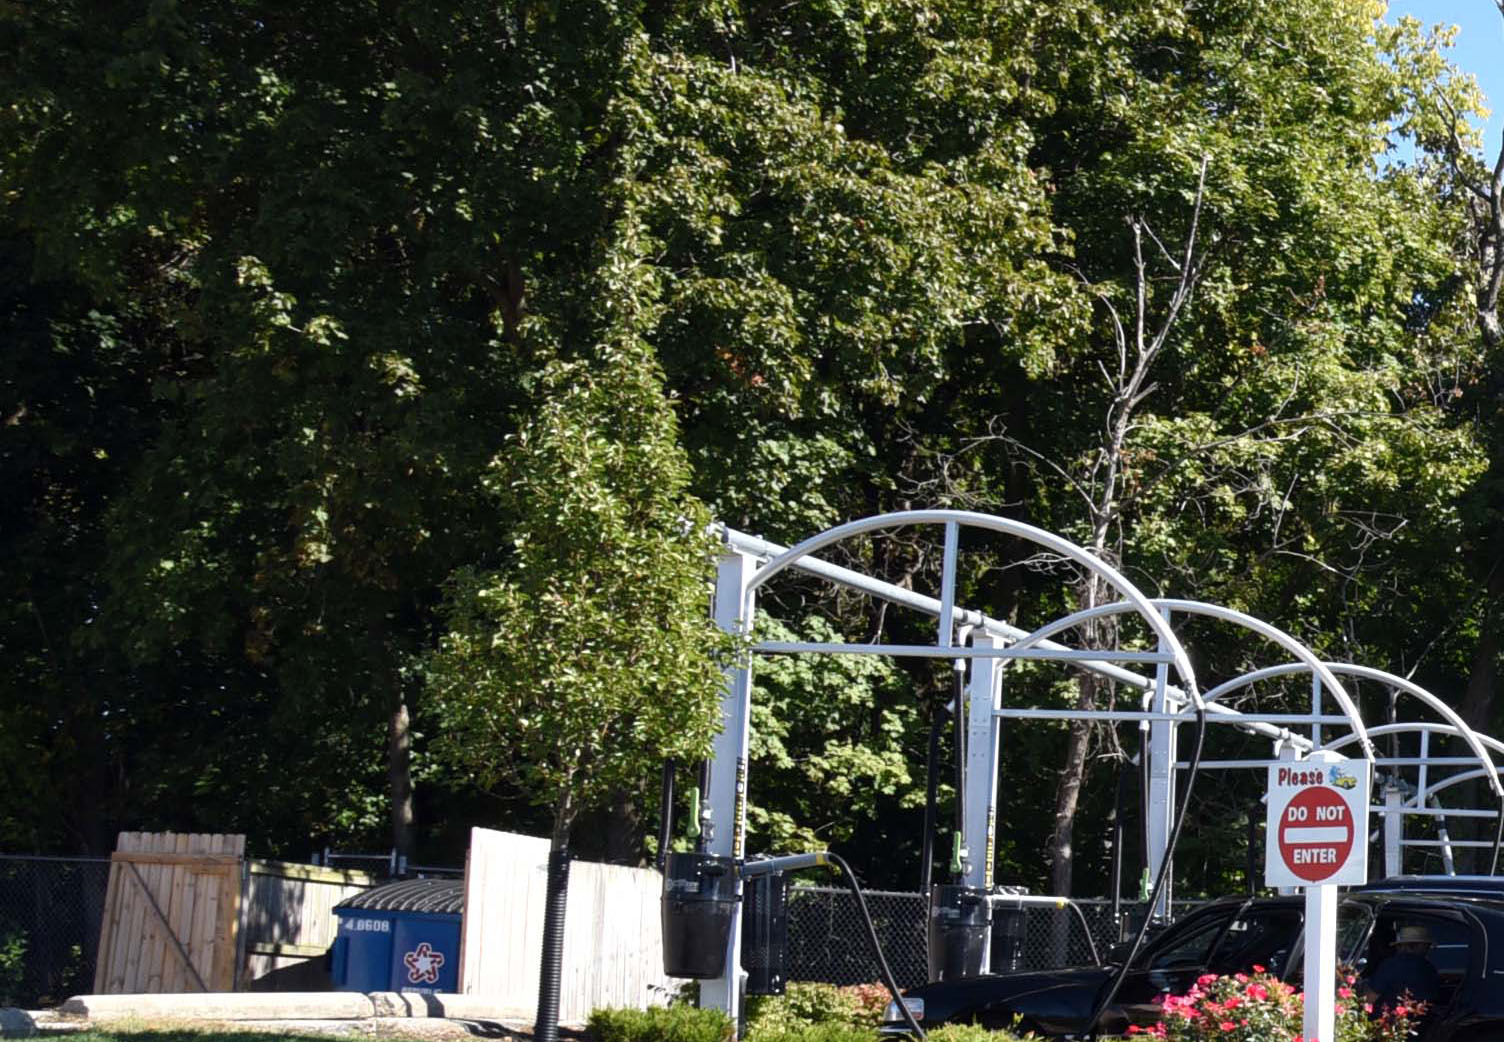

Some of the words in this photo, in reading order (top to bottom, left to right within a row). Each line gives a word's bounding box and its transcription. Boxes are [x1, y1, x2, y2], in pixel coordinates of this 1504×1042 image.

[1278, 766, 1324, 786] Please
[1287, 806, 1308, 821] DO
[1315, 806, 1346, 821] NOT
[1293, 847, 1337, 864] ENTER
